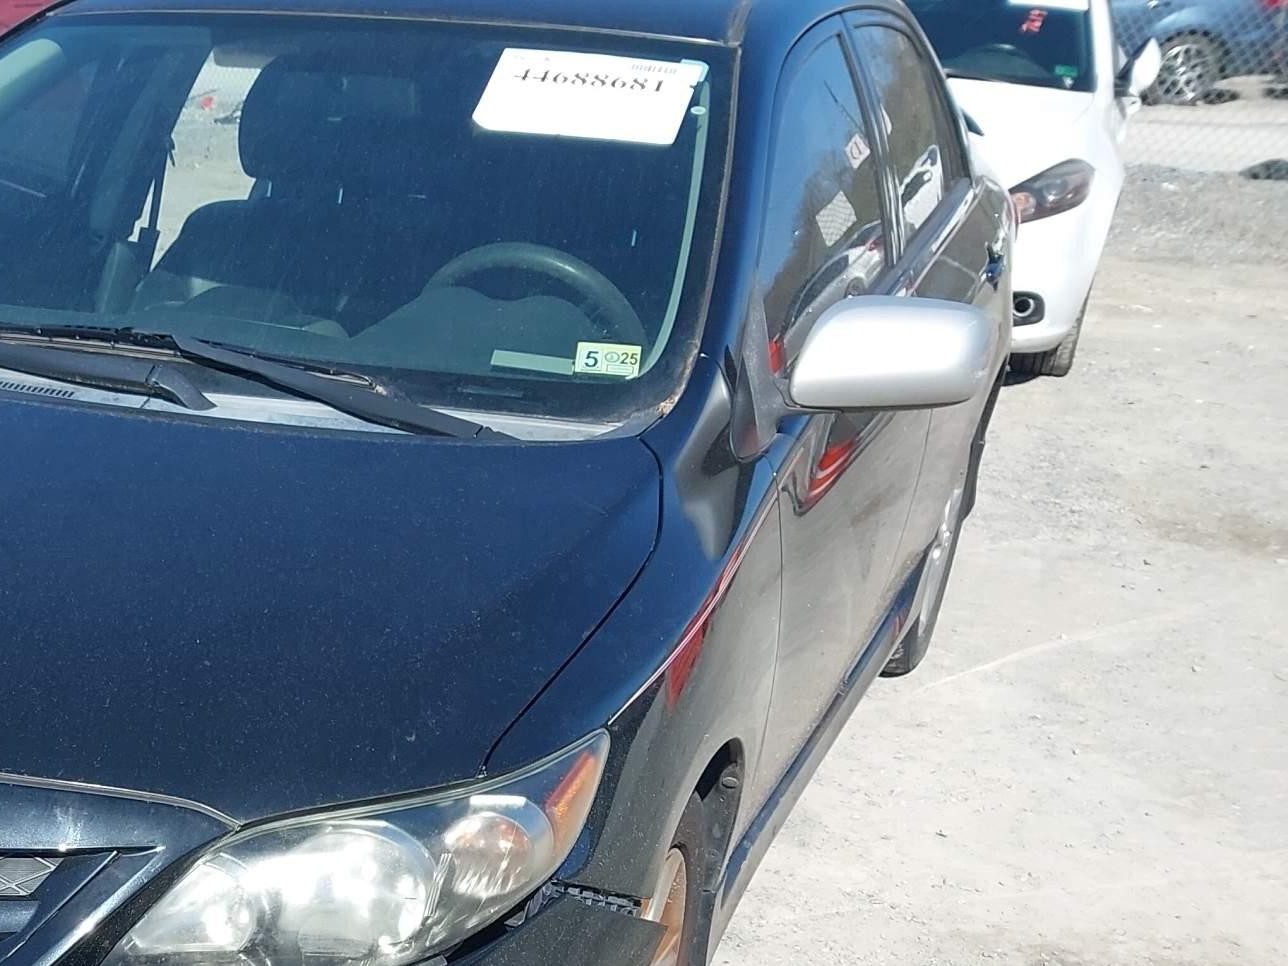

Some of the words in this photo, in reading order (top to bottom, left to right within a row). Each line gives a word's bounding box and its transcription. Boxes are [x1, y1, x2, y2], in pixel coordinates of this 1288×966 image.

[513, 67, 665, 93] 44688681
[584, 350, 599, 368] 5
[619, 352, 639, 366] 25
